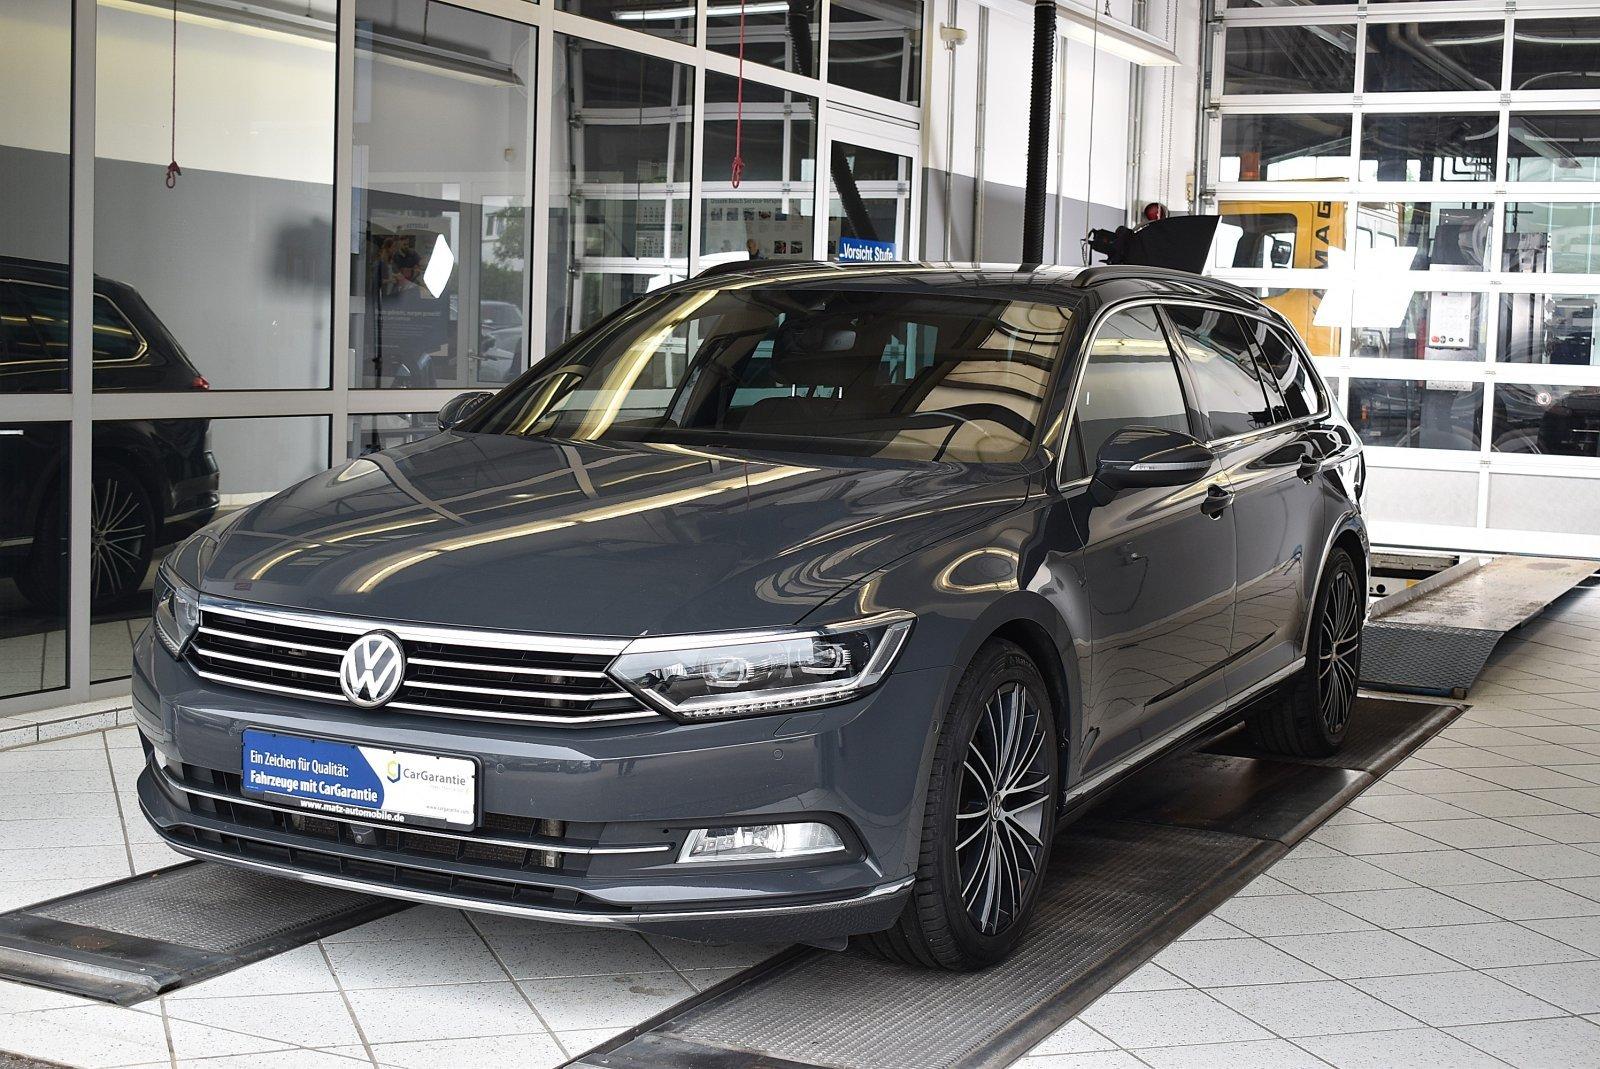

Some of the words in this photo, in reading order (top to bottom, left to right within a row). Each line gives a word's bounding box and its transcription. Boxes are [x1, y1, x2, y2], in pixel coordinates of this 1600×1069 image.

[843, 243, 873, 261] Vorsicht
[874, 246, 893, 262] Stufe
[250, 749, 263, 765] Ein
[264, 752, 296, 769] Zeichen
[298, 757, 310, 771] für
[311, 759, 349, 778] Qualität:
[250, 770, 298, 791] Fahrzeuge
[300, 779, 317, 793] mit
[318, 781, 378, 802] CarGarantie
[403, 768, 466, 786] CarGarantie
[300, 800, 405, 822] www.matz-automobile.de
